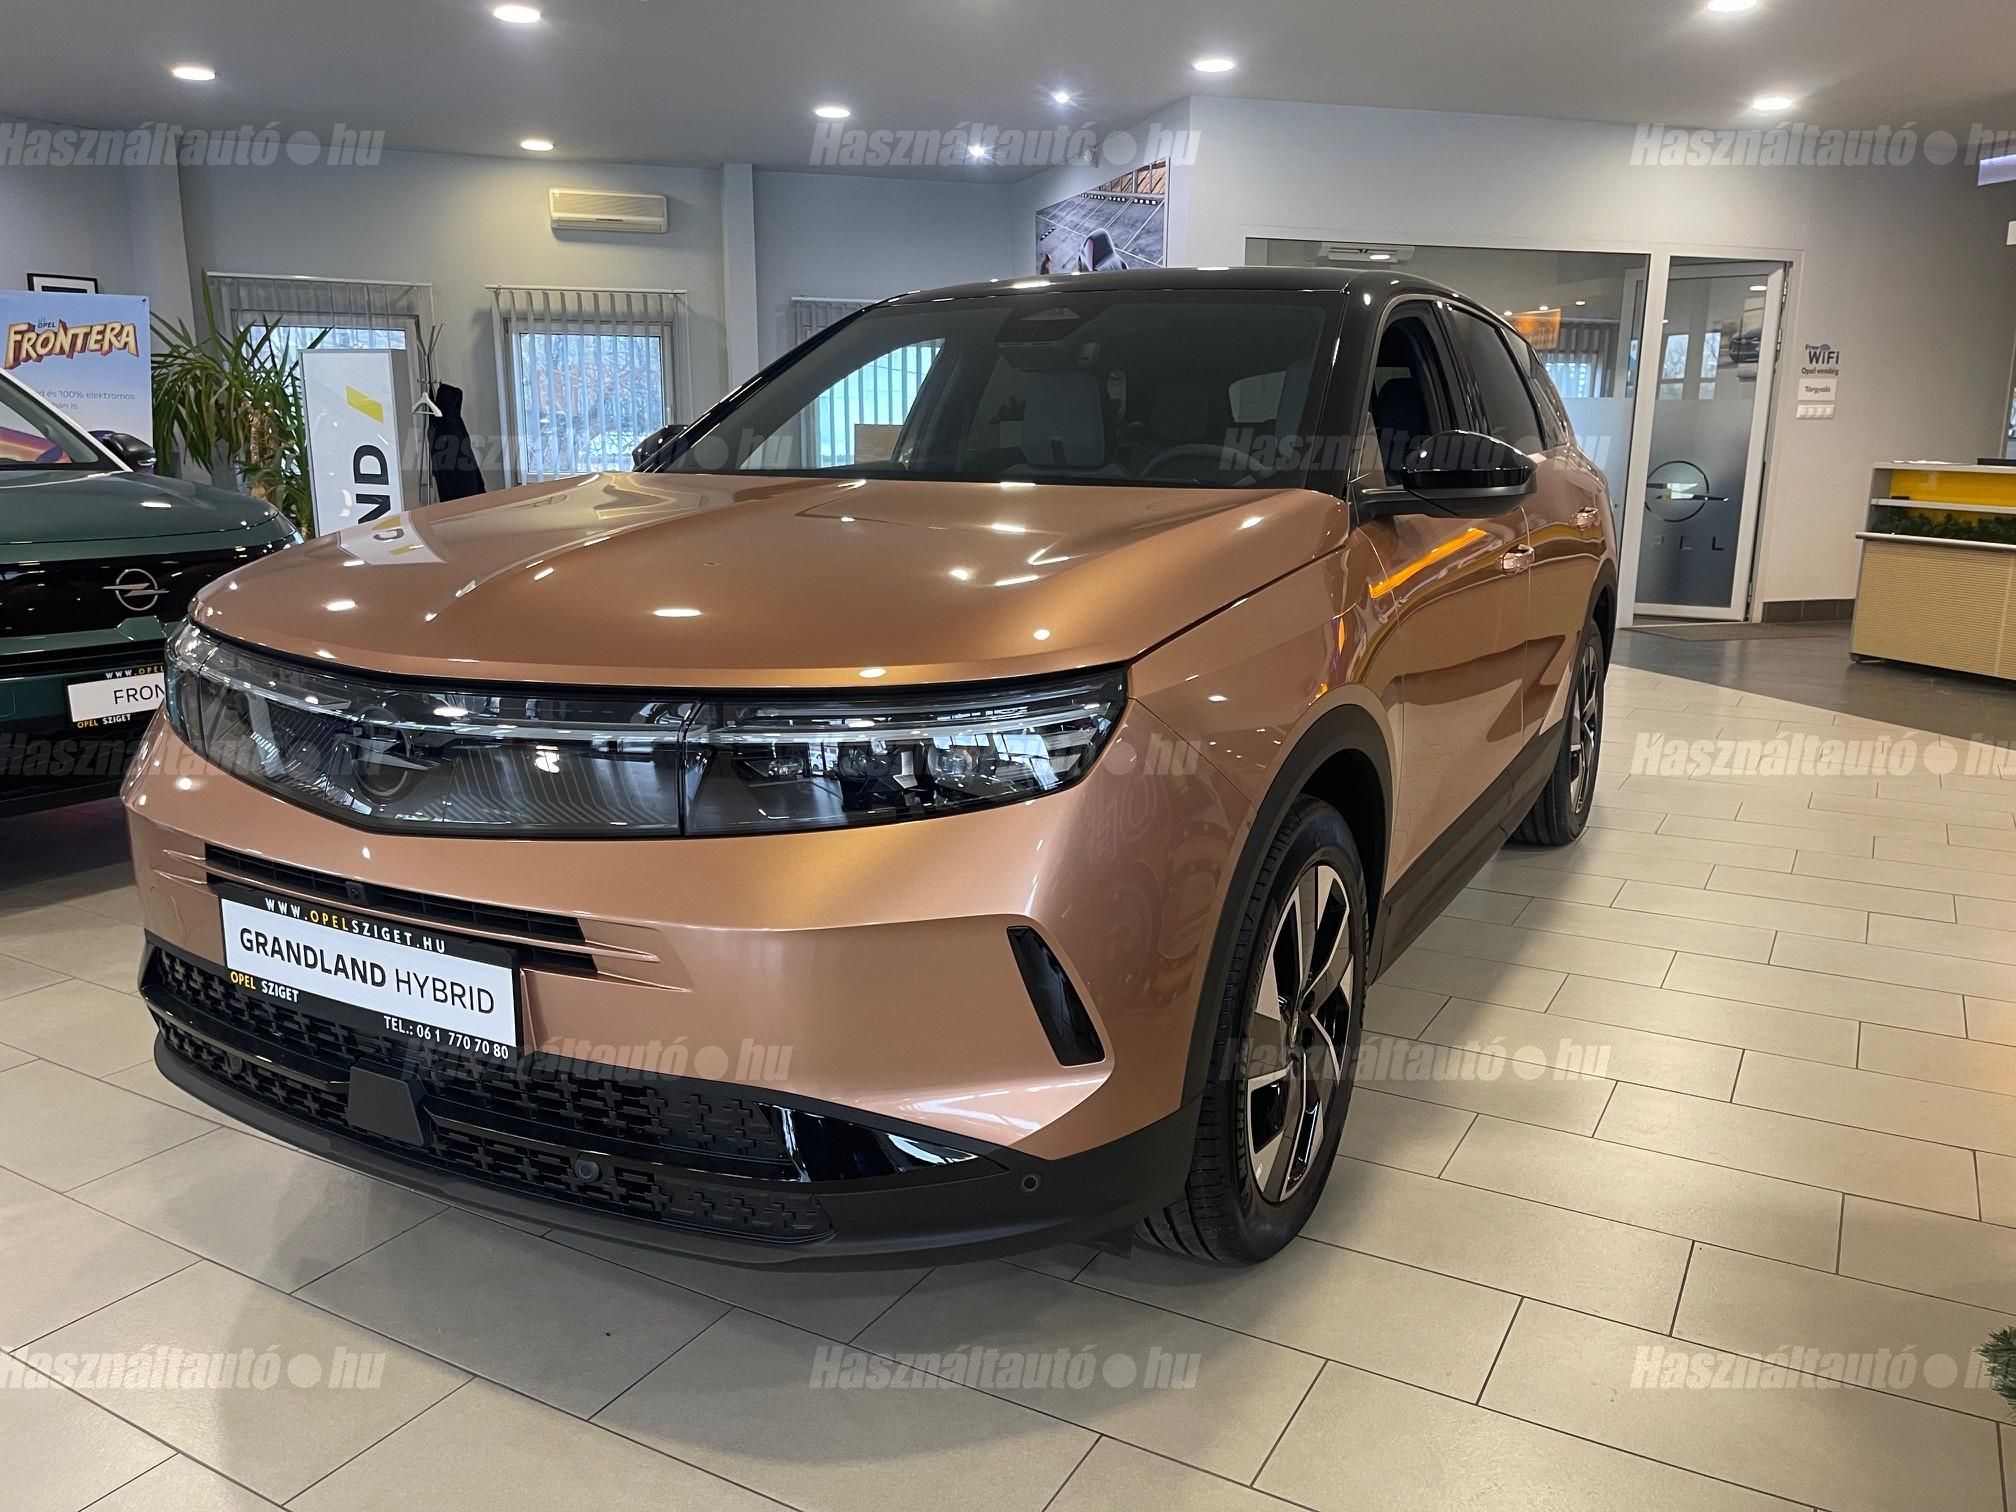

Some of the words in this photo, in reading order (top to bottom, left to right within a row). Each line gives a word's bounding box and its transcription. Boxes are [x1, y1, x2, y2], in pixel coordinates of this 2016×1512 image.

[4, 318, 140, 370] FRONTERA
[59, 390, 84, 398] 100%
[86, 391, 136, 400] elektromos
[77, 719, 99, 729] OPEL
[102, 713, 131, 725] SZIGET
[265, 897, 446, 954] WWW.OPELSZIGET.HU
[230, 971, 256, 990] OPEL
[261, 980, 299, 1003] SZIGET
[239, 927, 387, 988] GRANDLAND
[395, 968, 495, 1015] HYBRID
[383, 1015, 414, 1036] TEL.:
[448, 1032, 471, 1050] 770
[474, 1038, 490, 1055] 70
[493, 1043, 509, 1059] 80
